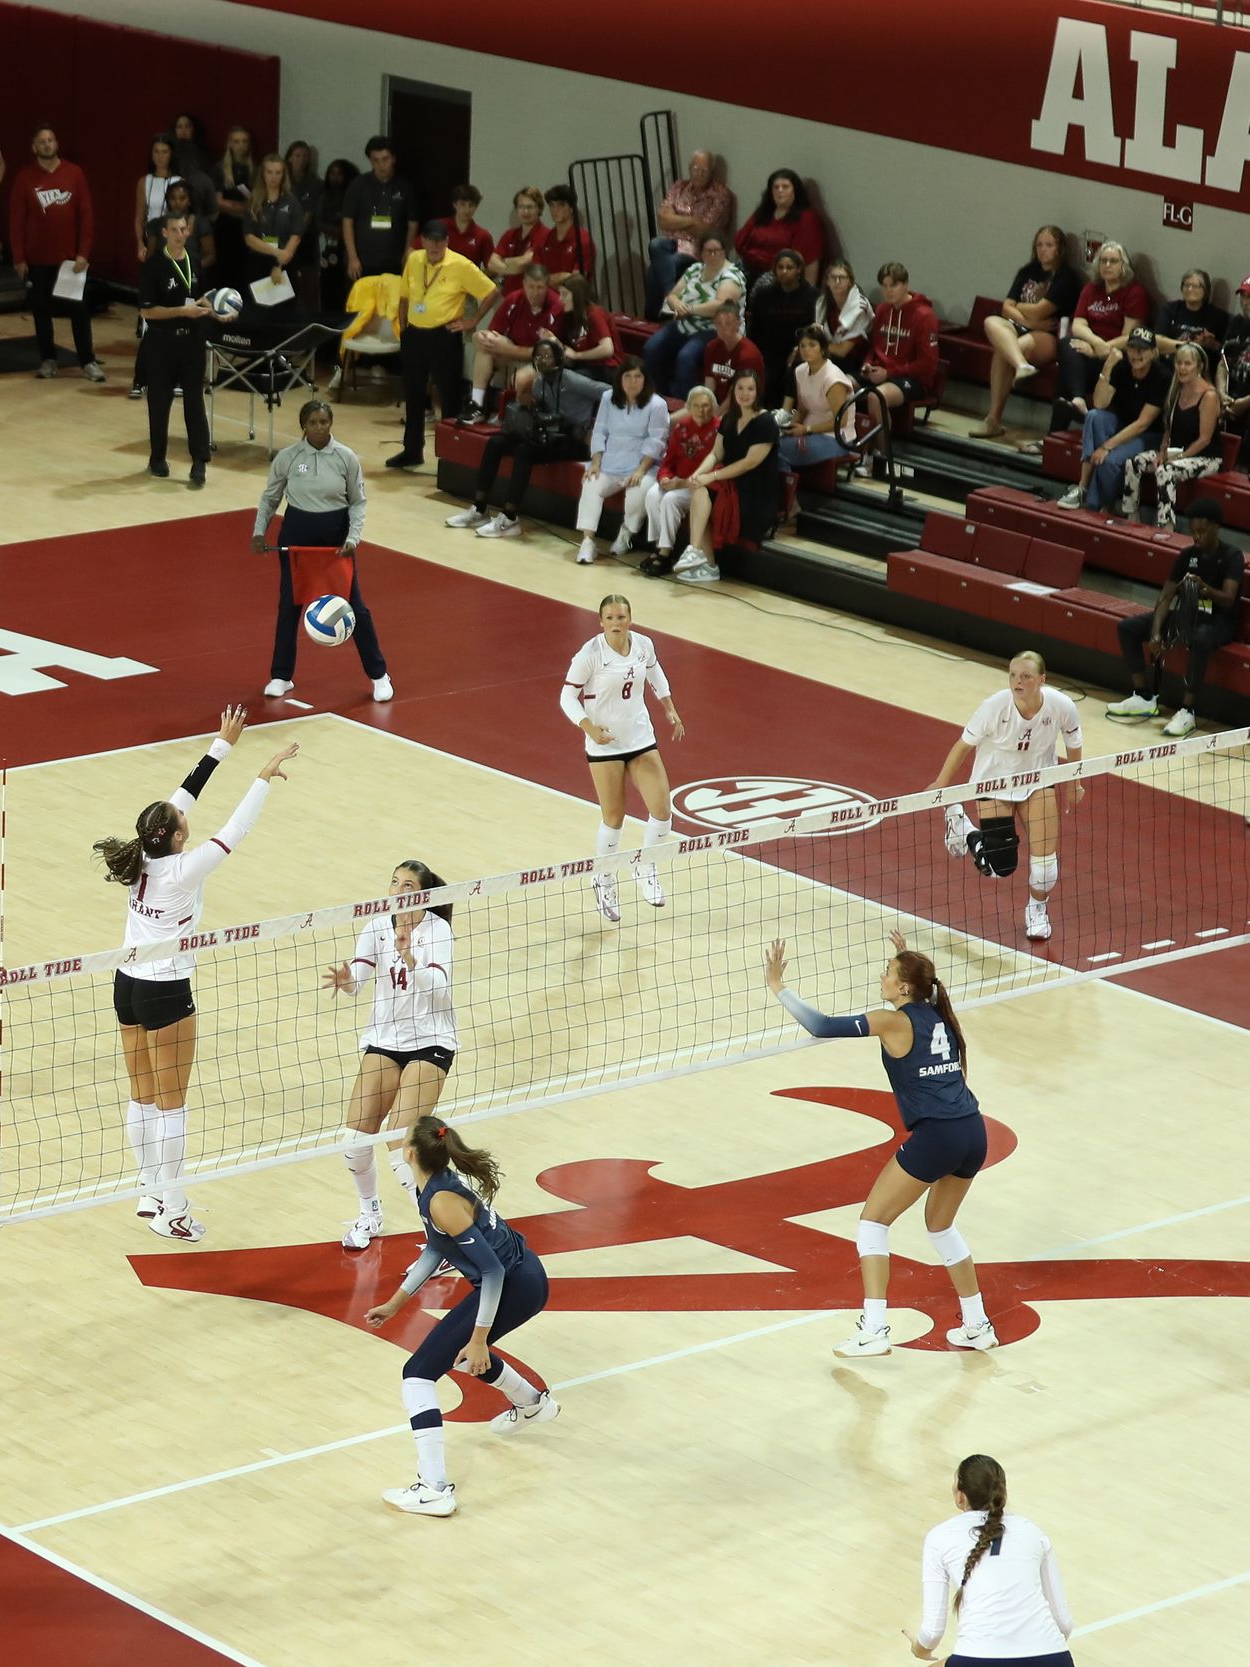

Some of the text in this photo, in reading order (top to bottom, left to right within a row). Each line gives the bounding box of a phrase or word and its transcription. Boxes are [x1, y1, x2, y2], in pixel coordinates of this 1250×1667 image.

[222, 333, 252, 346] molten
[621, 681, 634, 700] 8
[1017, 741, 1031, 752] 11
[1115, 744, 1178, 767] ROLL TIDE
[975, 771, 1041, 795] ROLL TIDE
[830, 799, 899, 823] ROLL TIDE
[678, 829, 750, 854] ROLL TIDE
[519, 858, 595, 886] ROLL TIDE
[137, 872, 149, 902] 1
[129, 898, 165, 919] RANT
[353, 891, 431, 918] ROLL TIDE
[179, 925, 261, 952] ROLL TIDE
[43, 958, 82, 976] TIDE
[390, 967, 408, 991] 14
[930, 1021, 951, 1061] 4
